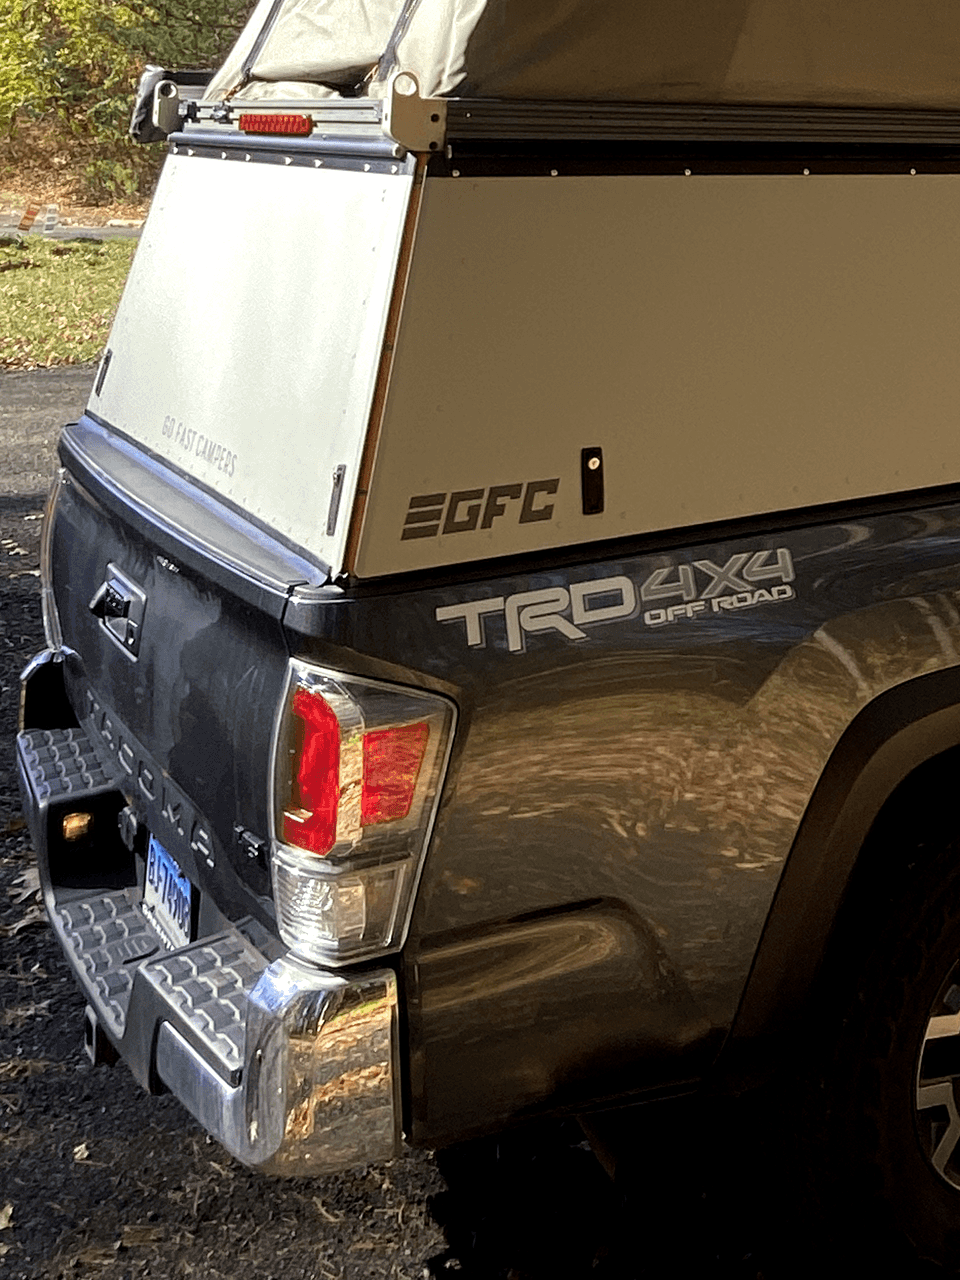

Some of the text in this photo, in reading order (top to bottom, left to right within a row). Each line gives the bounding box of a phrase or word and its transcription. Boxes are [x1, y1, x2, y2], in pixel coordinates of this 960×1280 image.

[161, 414, 238, 478] GO FAST CAMPERS
[435, 576, 639, 653] TRD
[643, 583, 797, 627] OFF ROAD
